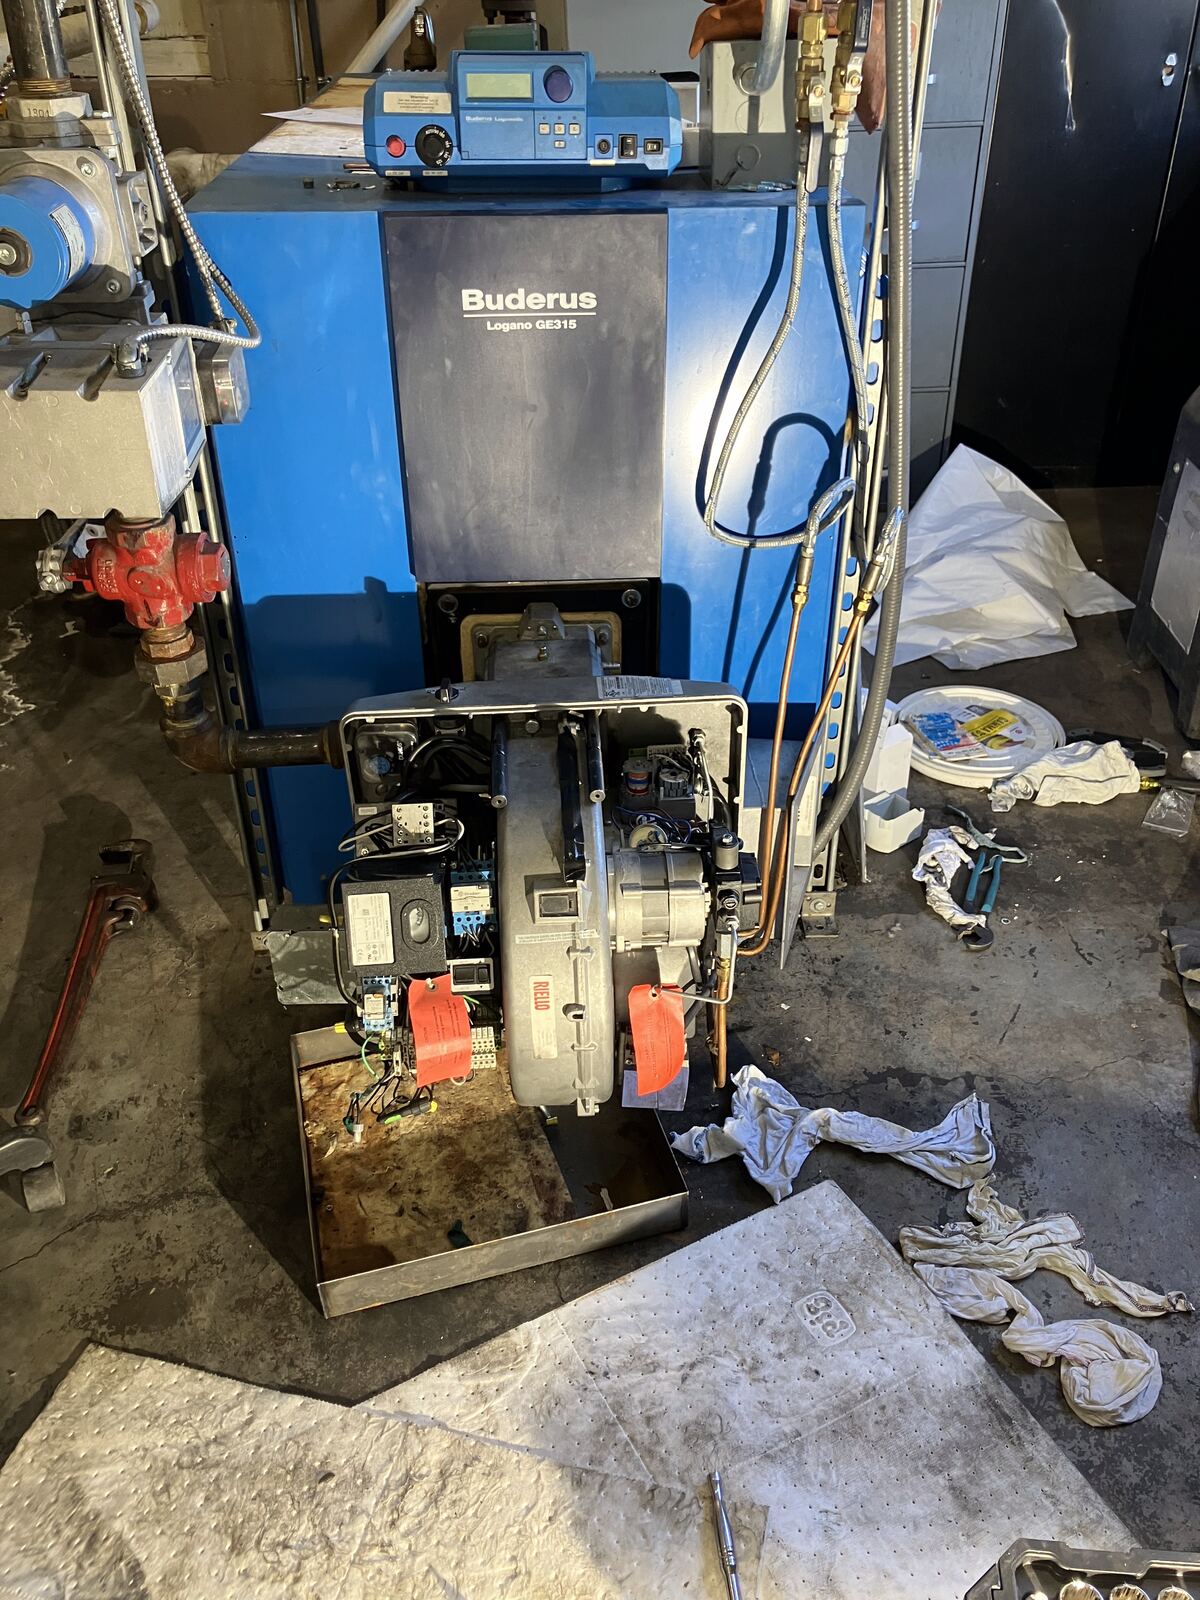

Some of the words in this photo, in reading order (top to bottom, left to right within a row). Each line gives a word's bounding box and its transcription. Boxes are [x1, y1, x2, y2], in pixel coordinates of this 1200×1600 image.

[461, 288, 598, 311] Buderus
[486, 320, 532, 332] Logano
[535, 319, 577, 330] GE315
[533, 981, 551, 1011] RIELLO
